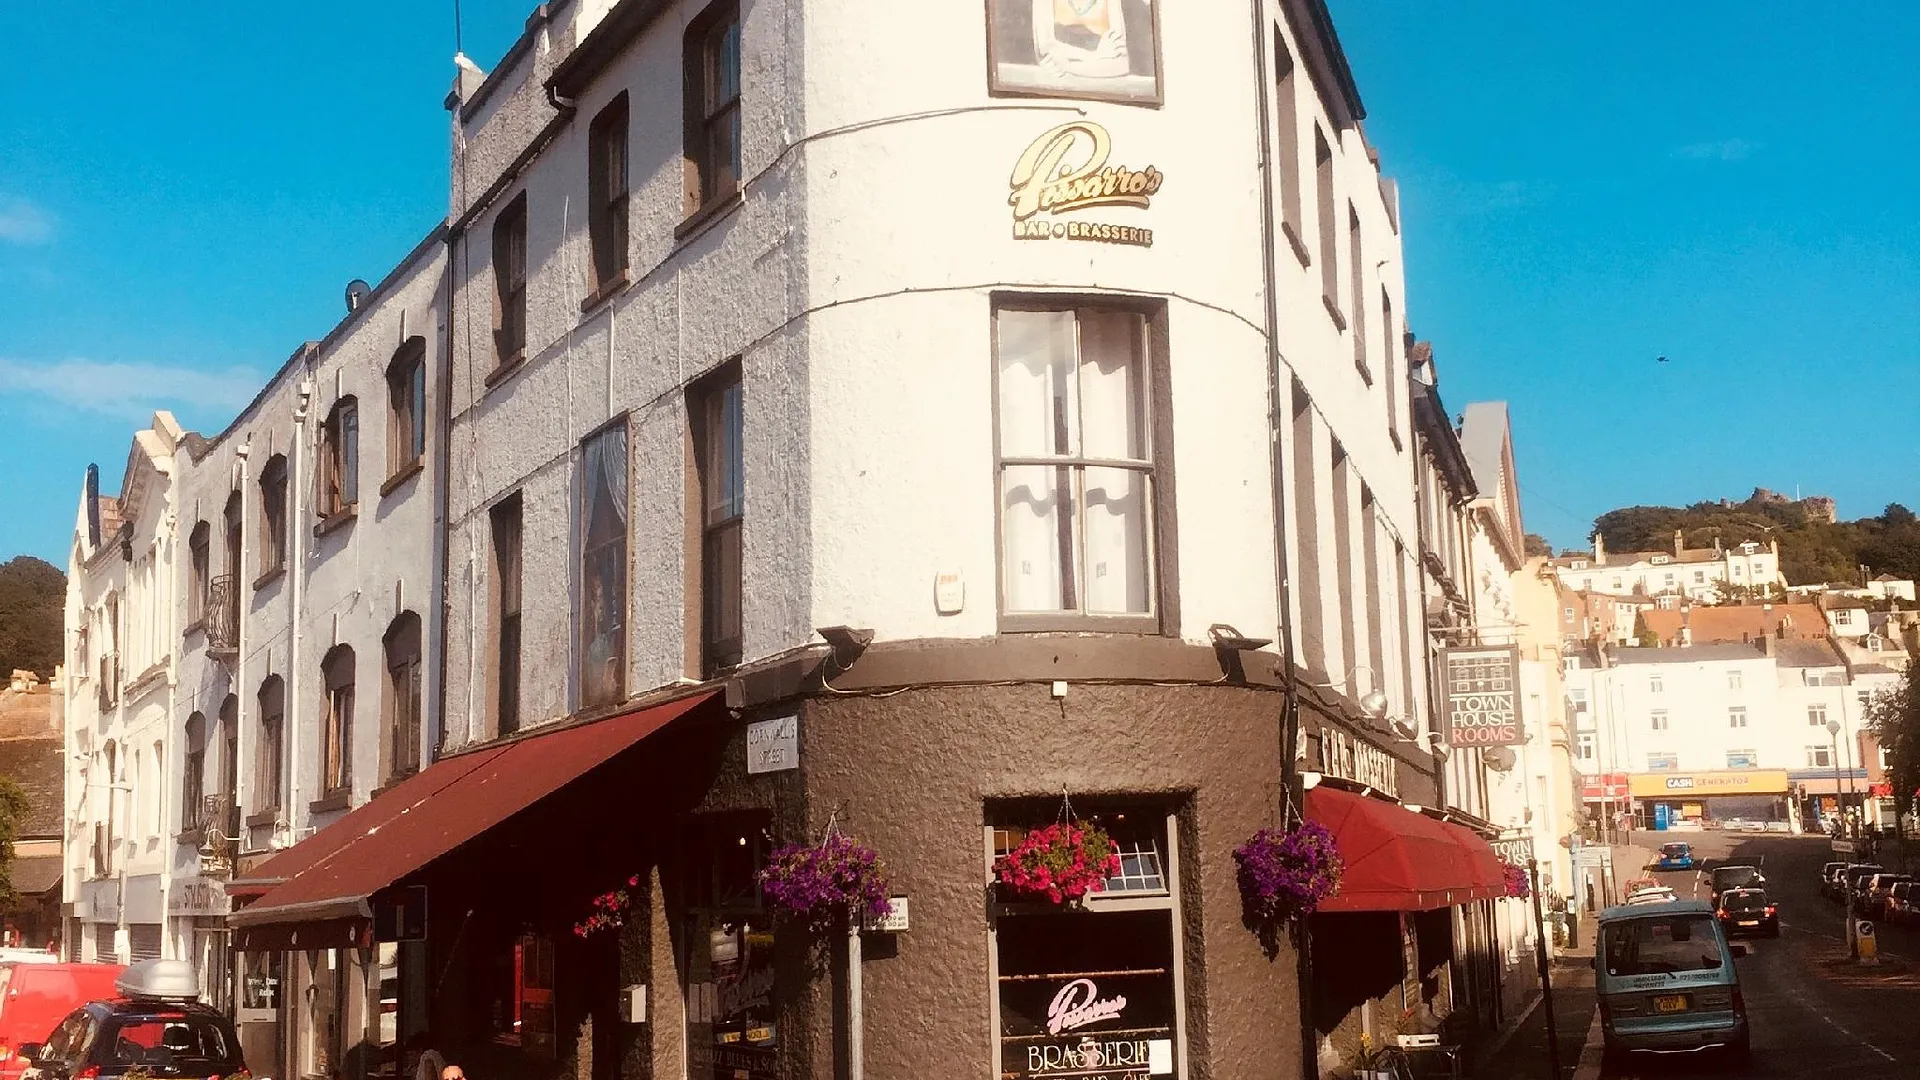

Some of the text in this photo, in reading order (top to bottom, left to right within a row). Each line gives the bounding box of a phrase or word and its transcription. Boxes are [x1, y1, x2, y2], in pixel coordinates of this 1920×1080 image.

[1013, 221, 1153, 247] BAR BRASSERIE
[1450, 695, 1514, 712] TOWN
[1451, 711, 1516, 728] HOUSE
[1452, 726, 1517, 744] ROOMS
[1667, 776, 1749, 788] CASH GENERATOR
[1490, 840, 1532, 857] TOWN
[1027, 1040, 1150, 1072] BRASSERIE
